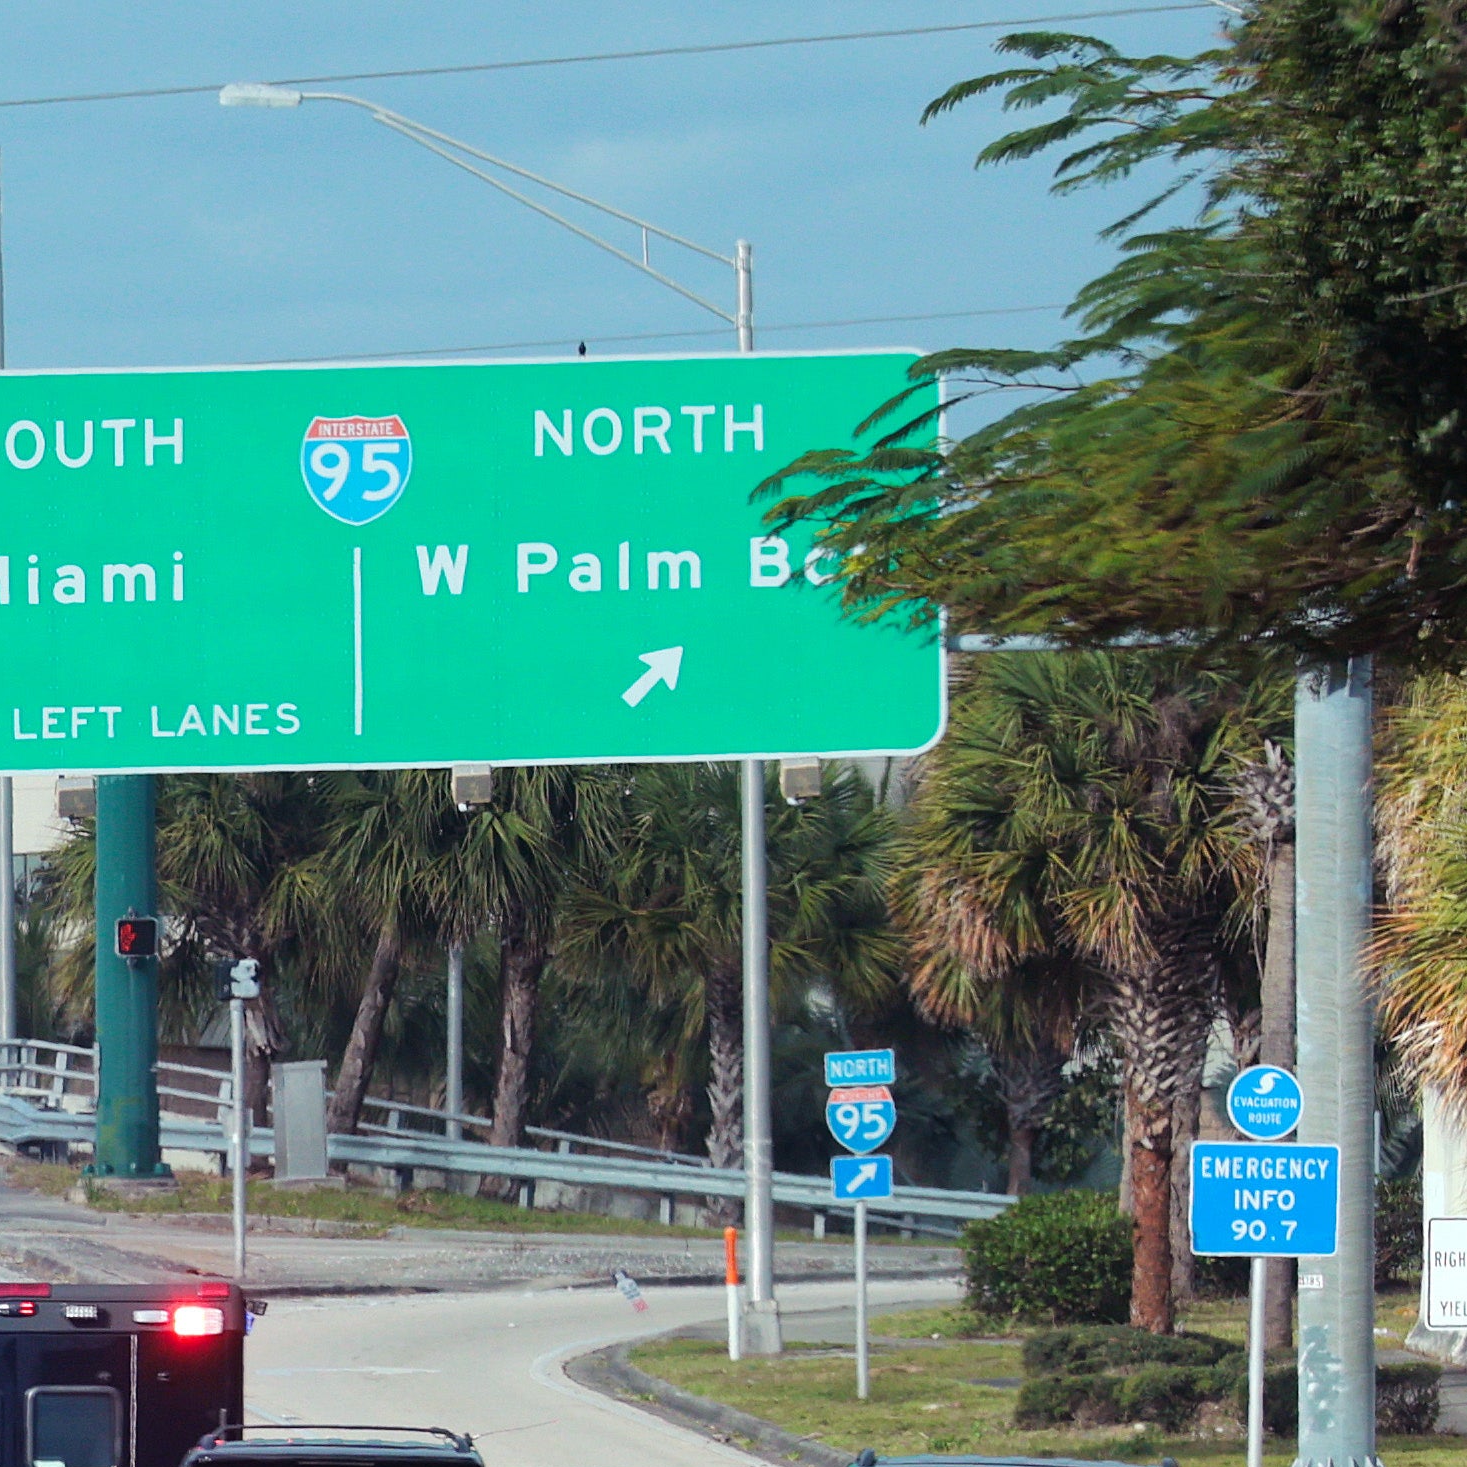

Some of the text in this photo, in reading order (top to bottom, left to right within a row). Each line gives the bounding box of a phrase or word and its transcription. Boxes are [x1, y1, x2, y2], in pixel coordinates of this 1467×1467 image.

[318, 422, 394, 436] INTERSTATE
[534, 404, 765, 457] NORTH
[310, 442, 400, 501] 95
[416, 544, 469, 596] W
[517, 540, 703, 593] Palm
[12, 705, 123, 740] LEFT
[150, 702, 301, 738] LANES
[830, 1058, 889, 1078] NORTH
[1234, 1096, 1298, 1109] EVACUATION
[835, 1103, 887, 1140] 95
[1248, 1112, 1282, 1125] ROUTE
[1201, 1156, 1329, 1181] EMERGENCY
[1234, 1189, 1296, 1211] INFO
[1231, 1219, 1298, 1241] 90.7
